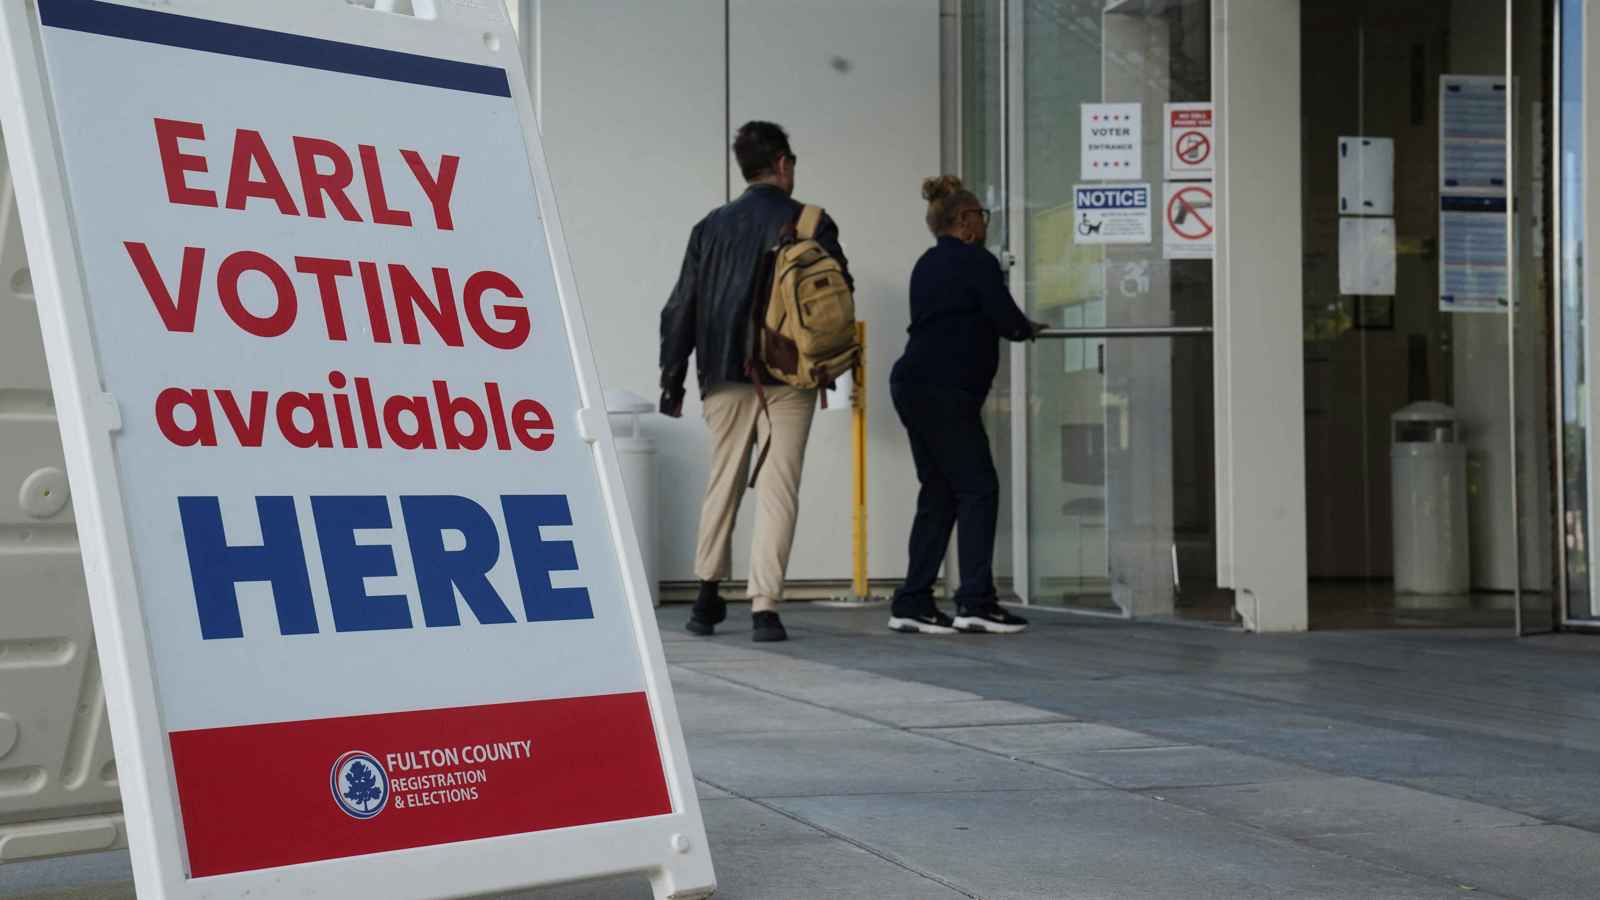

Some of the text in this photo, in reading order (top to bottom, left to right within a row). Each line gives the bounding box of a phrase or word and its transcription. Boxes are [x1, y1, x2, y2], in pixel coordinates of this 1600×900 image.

[1091, 128, 1131, 136] VOTER
[154, 118, 460, 231] EARLY
[1078, 190, 1146, 207] NOTICE
[123, 241, 531, 350] VOTING
[156, 371, 555, 452] available
[177, 494, 594, 641] HERE
[387, 740, 533, 772] FULTON COUNTY
[391, 769, 487, 792] REGISTRATION
[395, 787, 479, 809] & ELECTIONS
